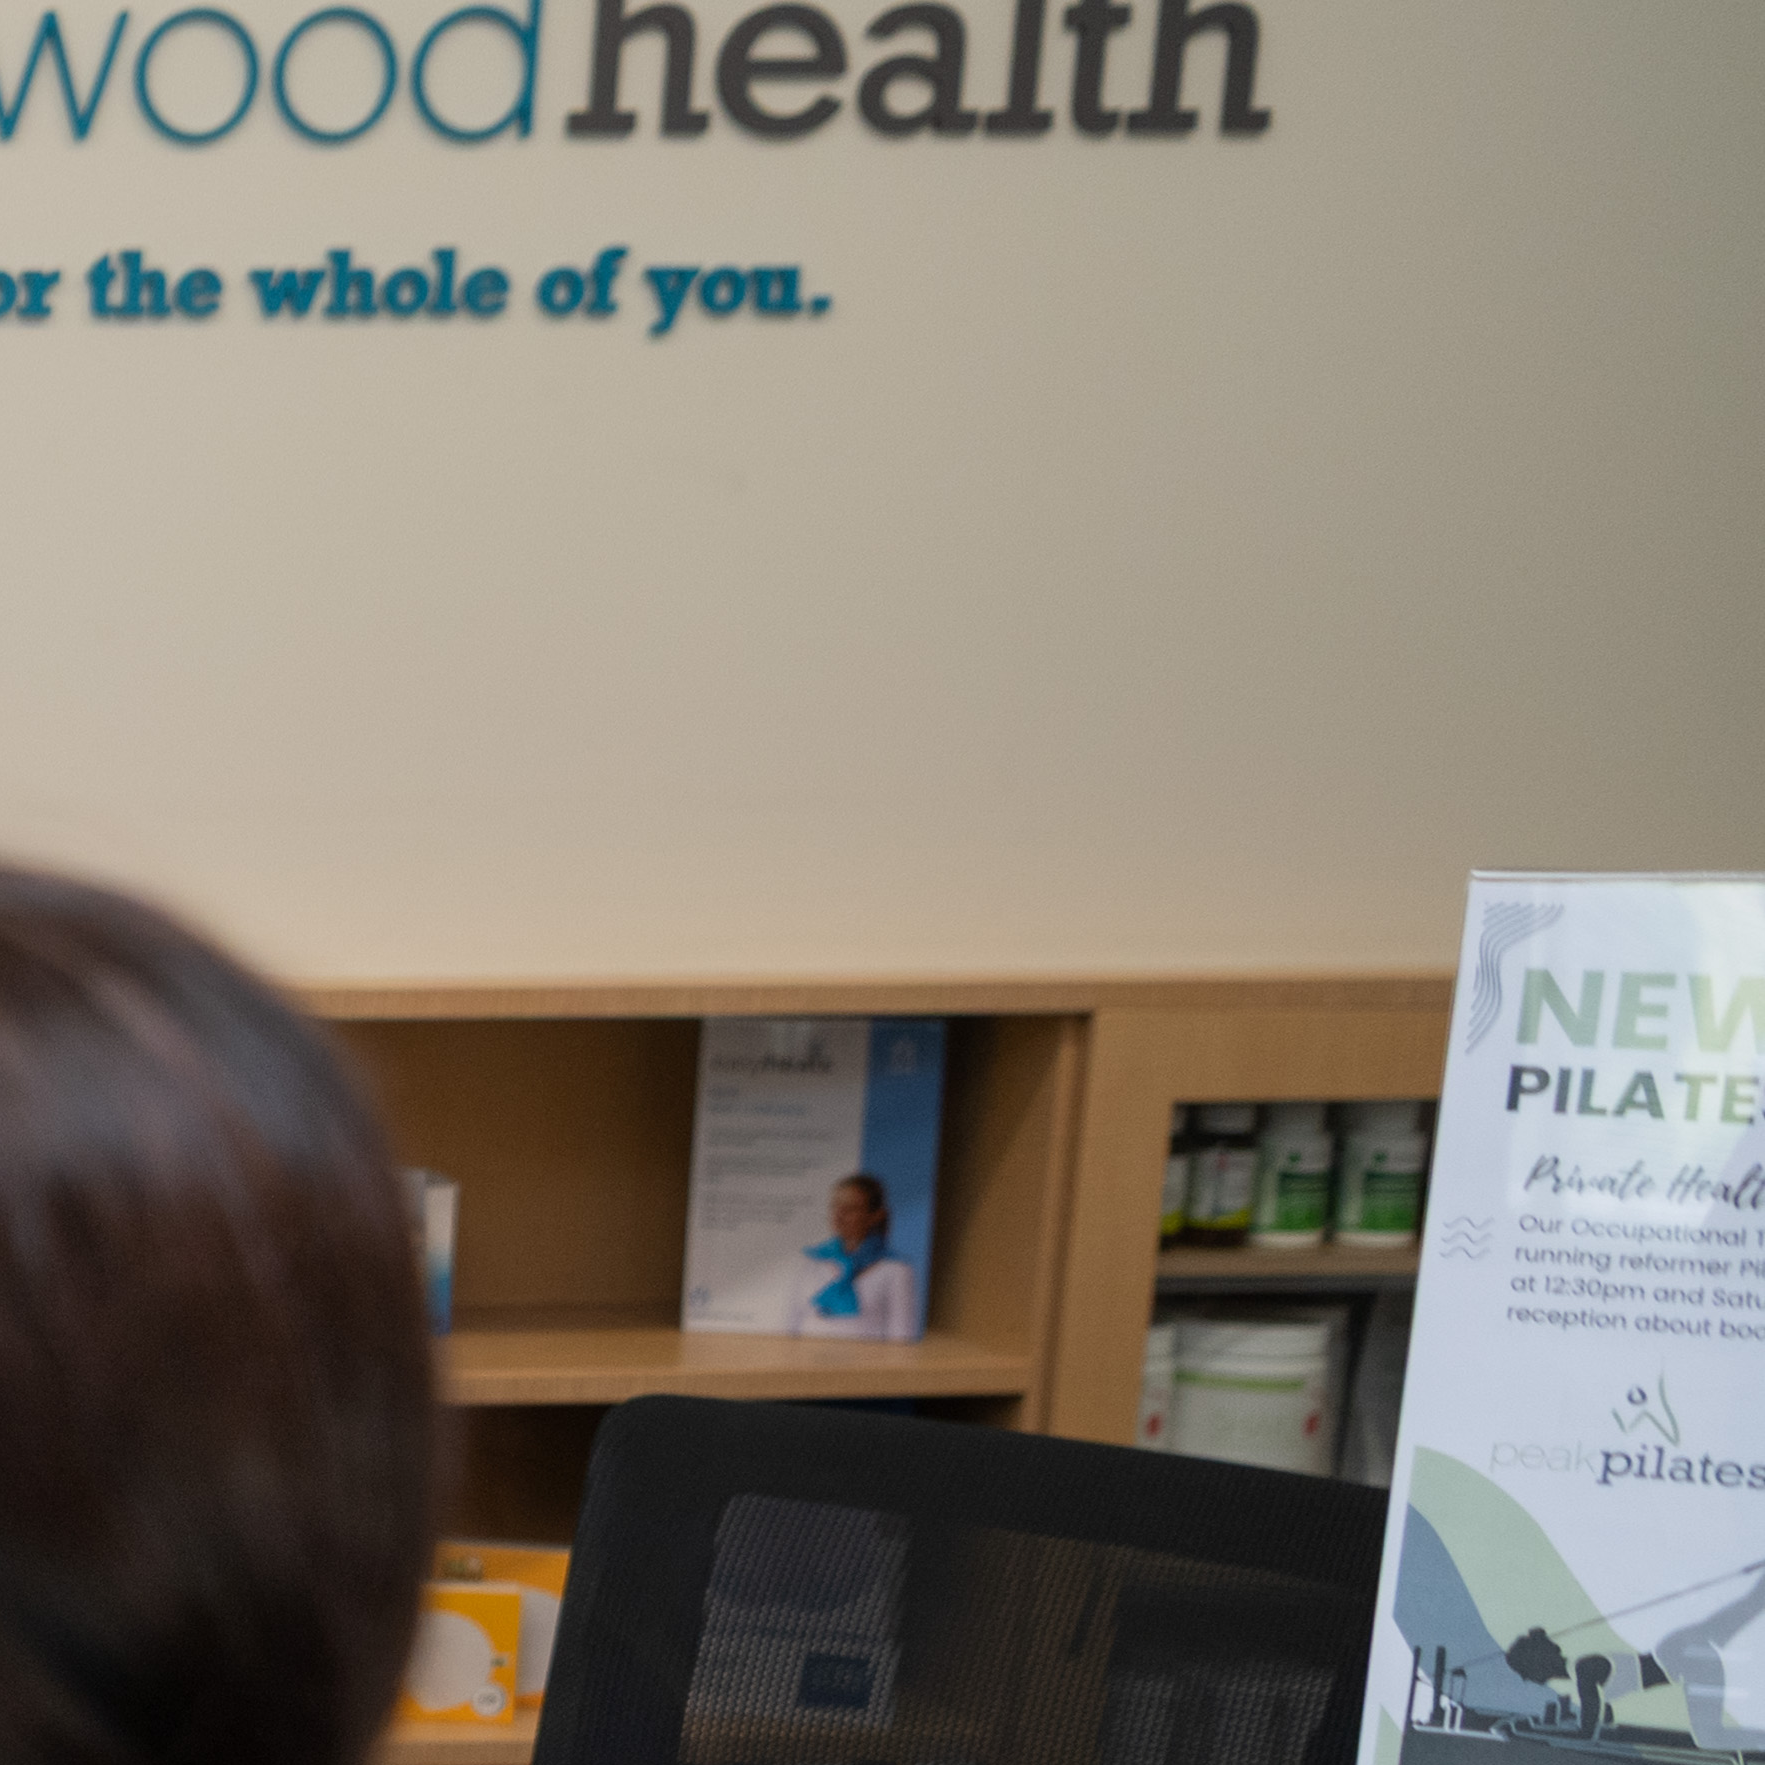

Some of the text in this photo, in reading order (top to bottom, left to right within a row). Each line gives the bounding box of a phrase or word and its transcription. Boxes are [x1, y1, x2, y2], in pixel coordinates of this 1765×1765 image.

[85, 249, 223, 321] the
[249, 248, 511, 321] whole
[537, 246, 629, 319] of
[644, 264, 833, 339] you.
[1505, 1063, 1765, 1125] PILATE
[1524, 1154, 1654, 1203] Private
[1519, 1213, 1563, 1234] Our
[1571, 1215, 1747, 1248] Occupational
[1514, 1246, 1611, 1273] running
[1619, 1252, 1729, 1275] reformer
[1510, 1275, 1536, 1293] at
[1544, 1274, 1646, 1303] 12:30pm
[1652, 1286, 1704, 1306] and
[1507, 1305, 1627, 1330] reception
[1634, 1312, 1712, 1337] about
